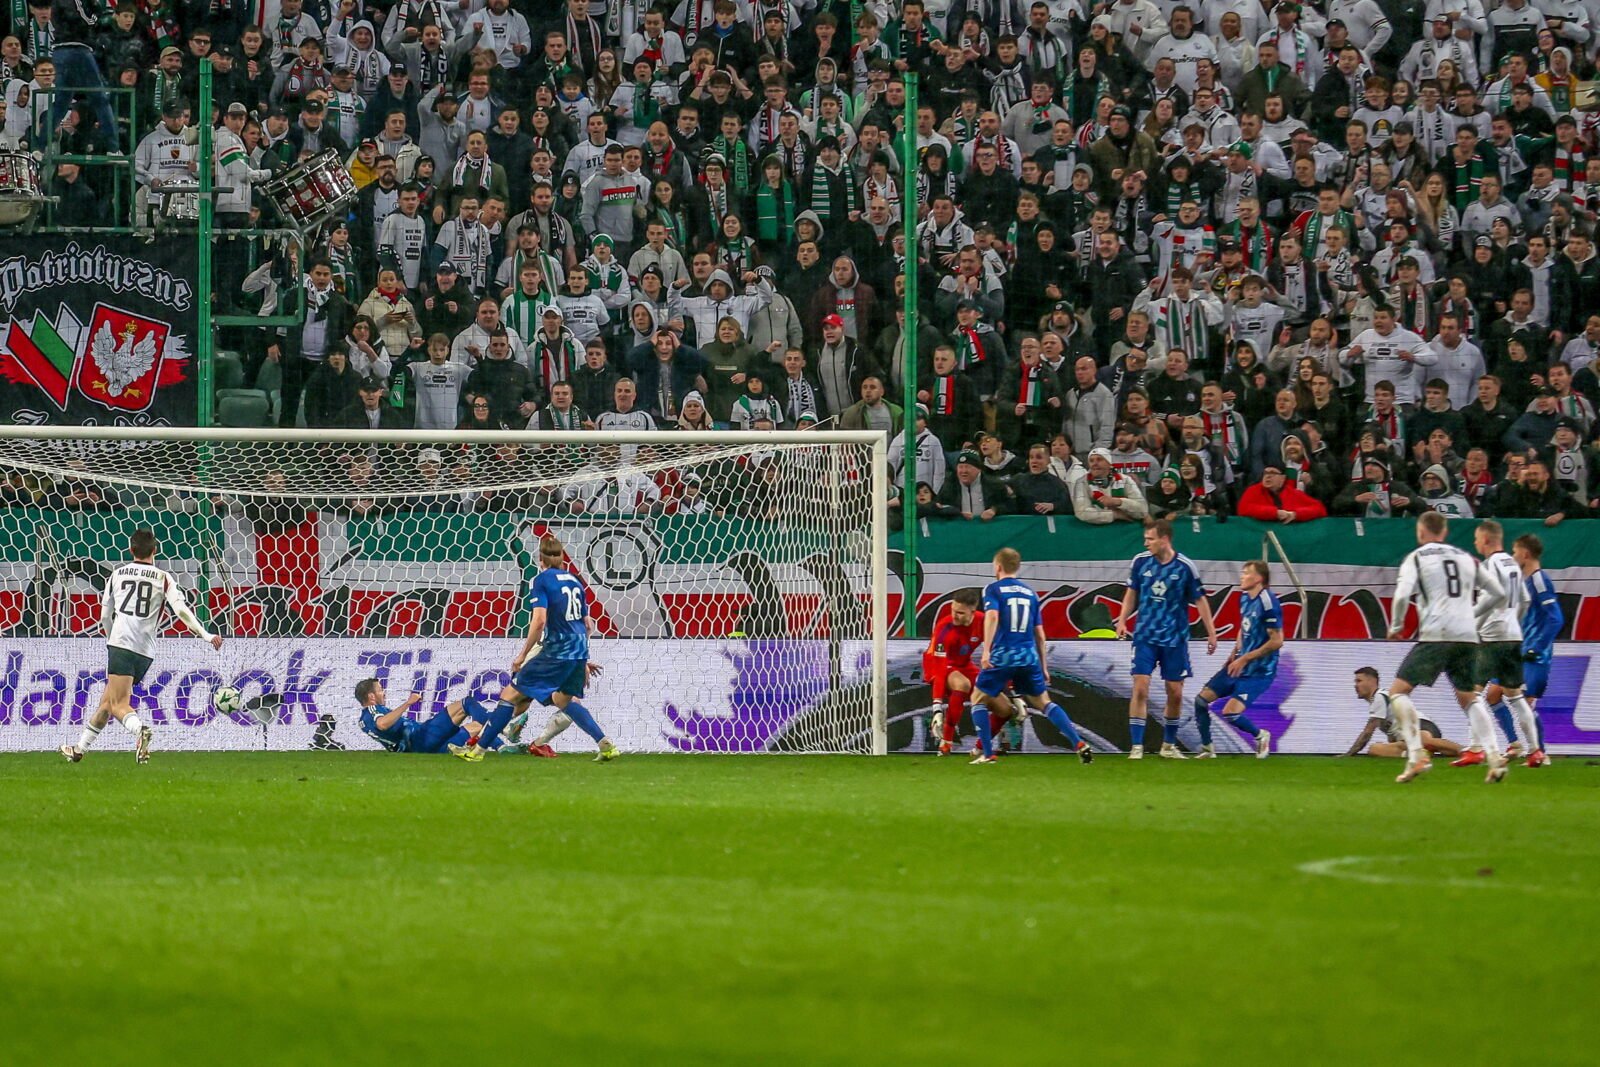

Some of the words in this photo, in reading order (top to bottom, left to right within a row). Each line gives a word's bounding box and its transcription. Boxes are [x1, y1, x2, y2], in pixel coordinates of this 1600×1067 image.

[118, 568, 139, 578] MARC
[141, 569, 159, 580] GUAL
[1443, 559, 1462, 598] 8
[119, 580, 153, 618] 28
[561, 585, 582, 622] 26
[1007, 597, 1031, 632] 17
